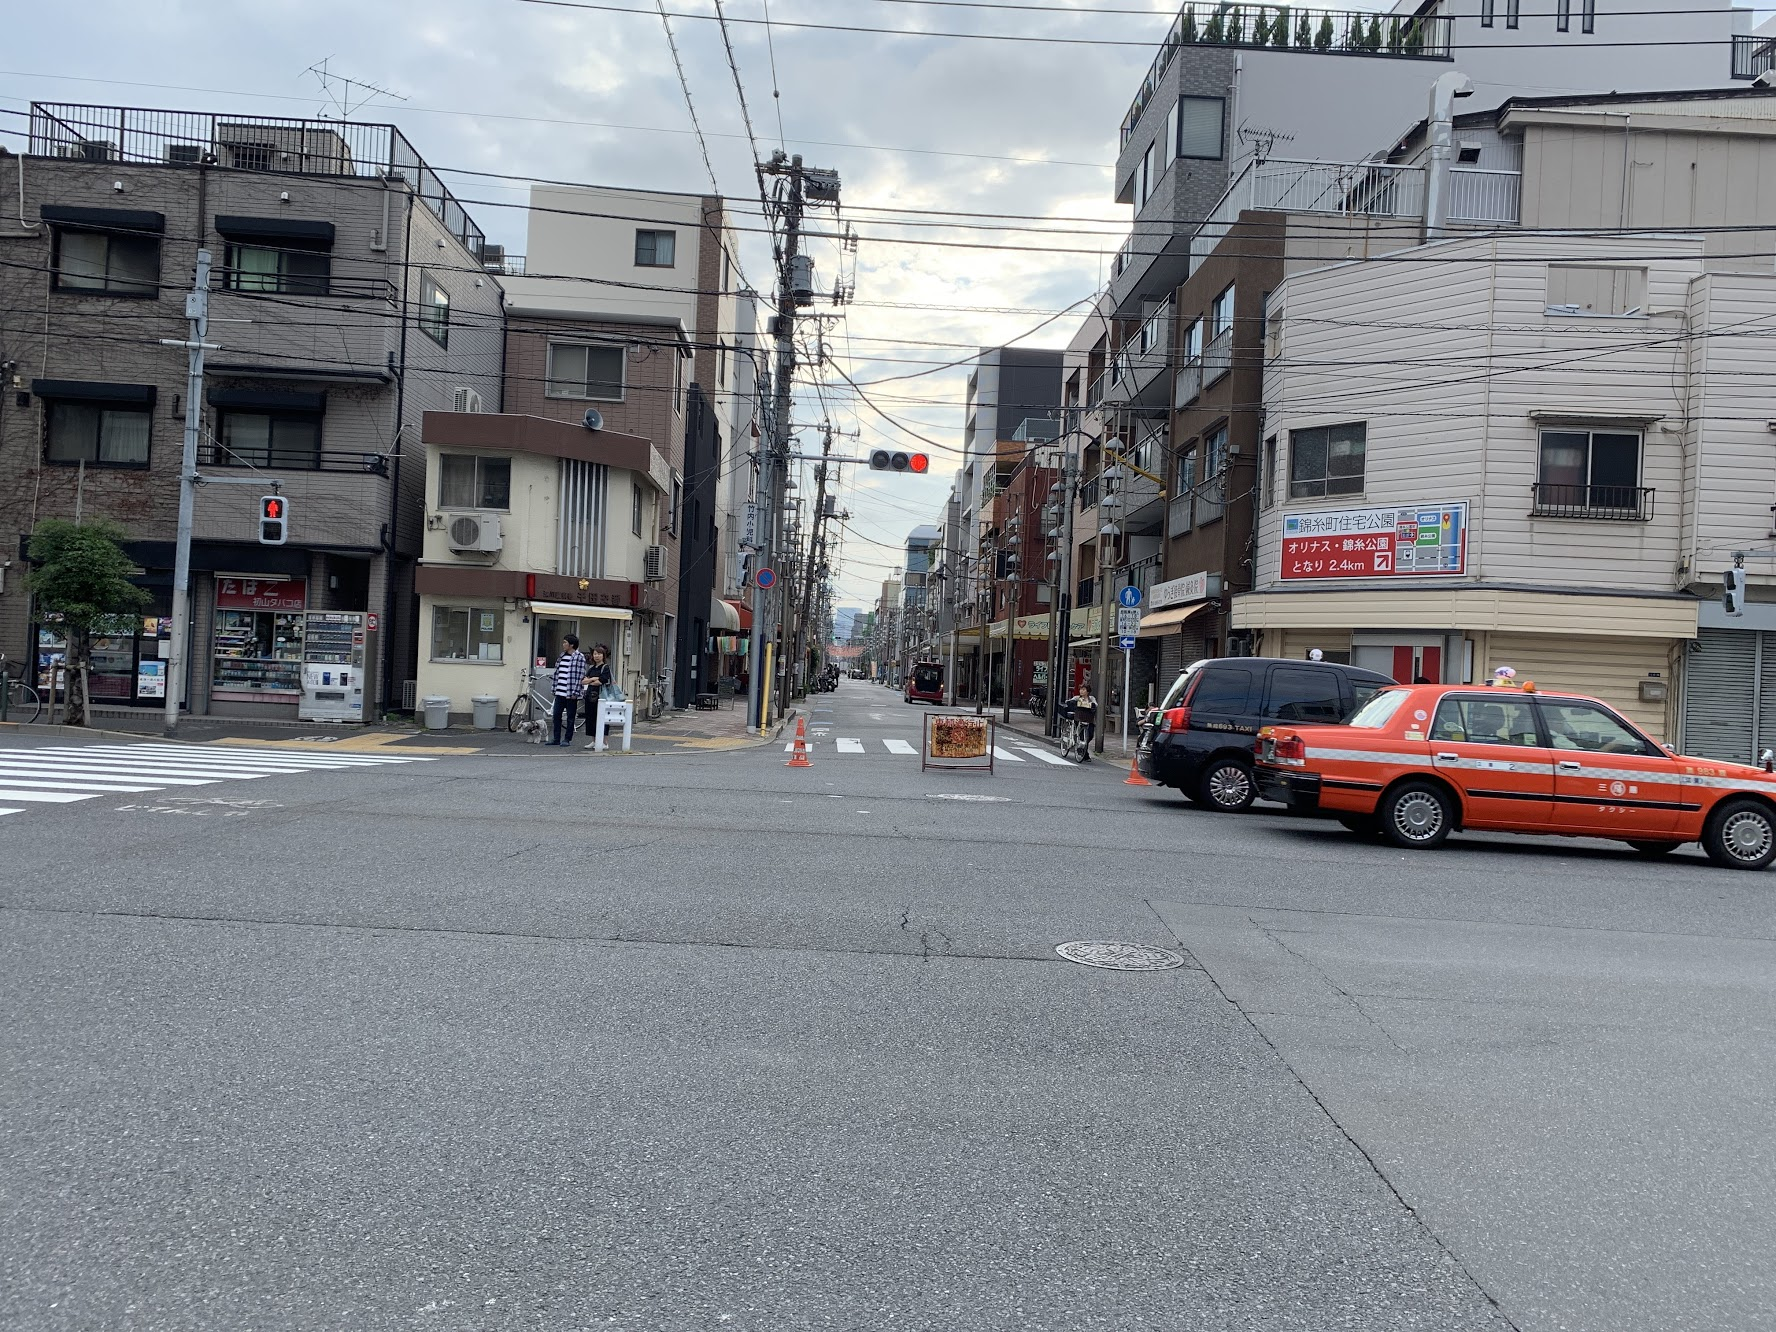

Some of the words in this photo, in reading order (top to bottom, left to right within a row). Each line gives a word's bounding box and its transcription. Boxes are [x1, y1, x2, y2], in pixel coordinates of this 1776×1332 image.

[1299, 512, 1395, 533] 錦糸町住宅公園
[1288, 537, 1389, 554] オリナス・錦糸公園
[1292, 560, 1323, 573] となり
[1329, 559, 1365, 571] 2.4km
[252, 597, 303, 609] 初山タバコ店
